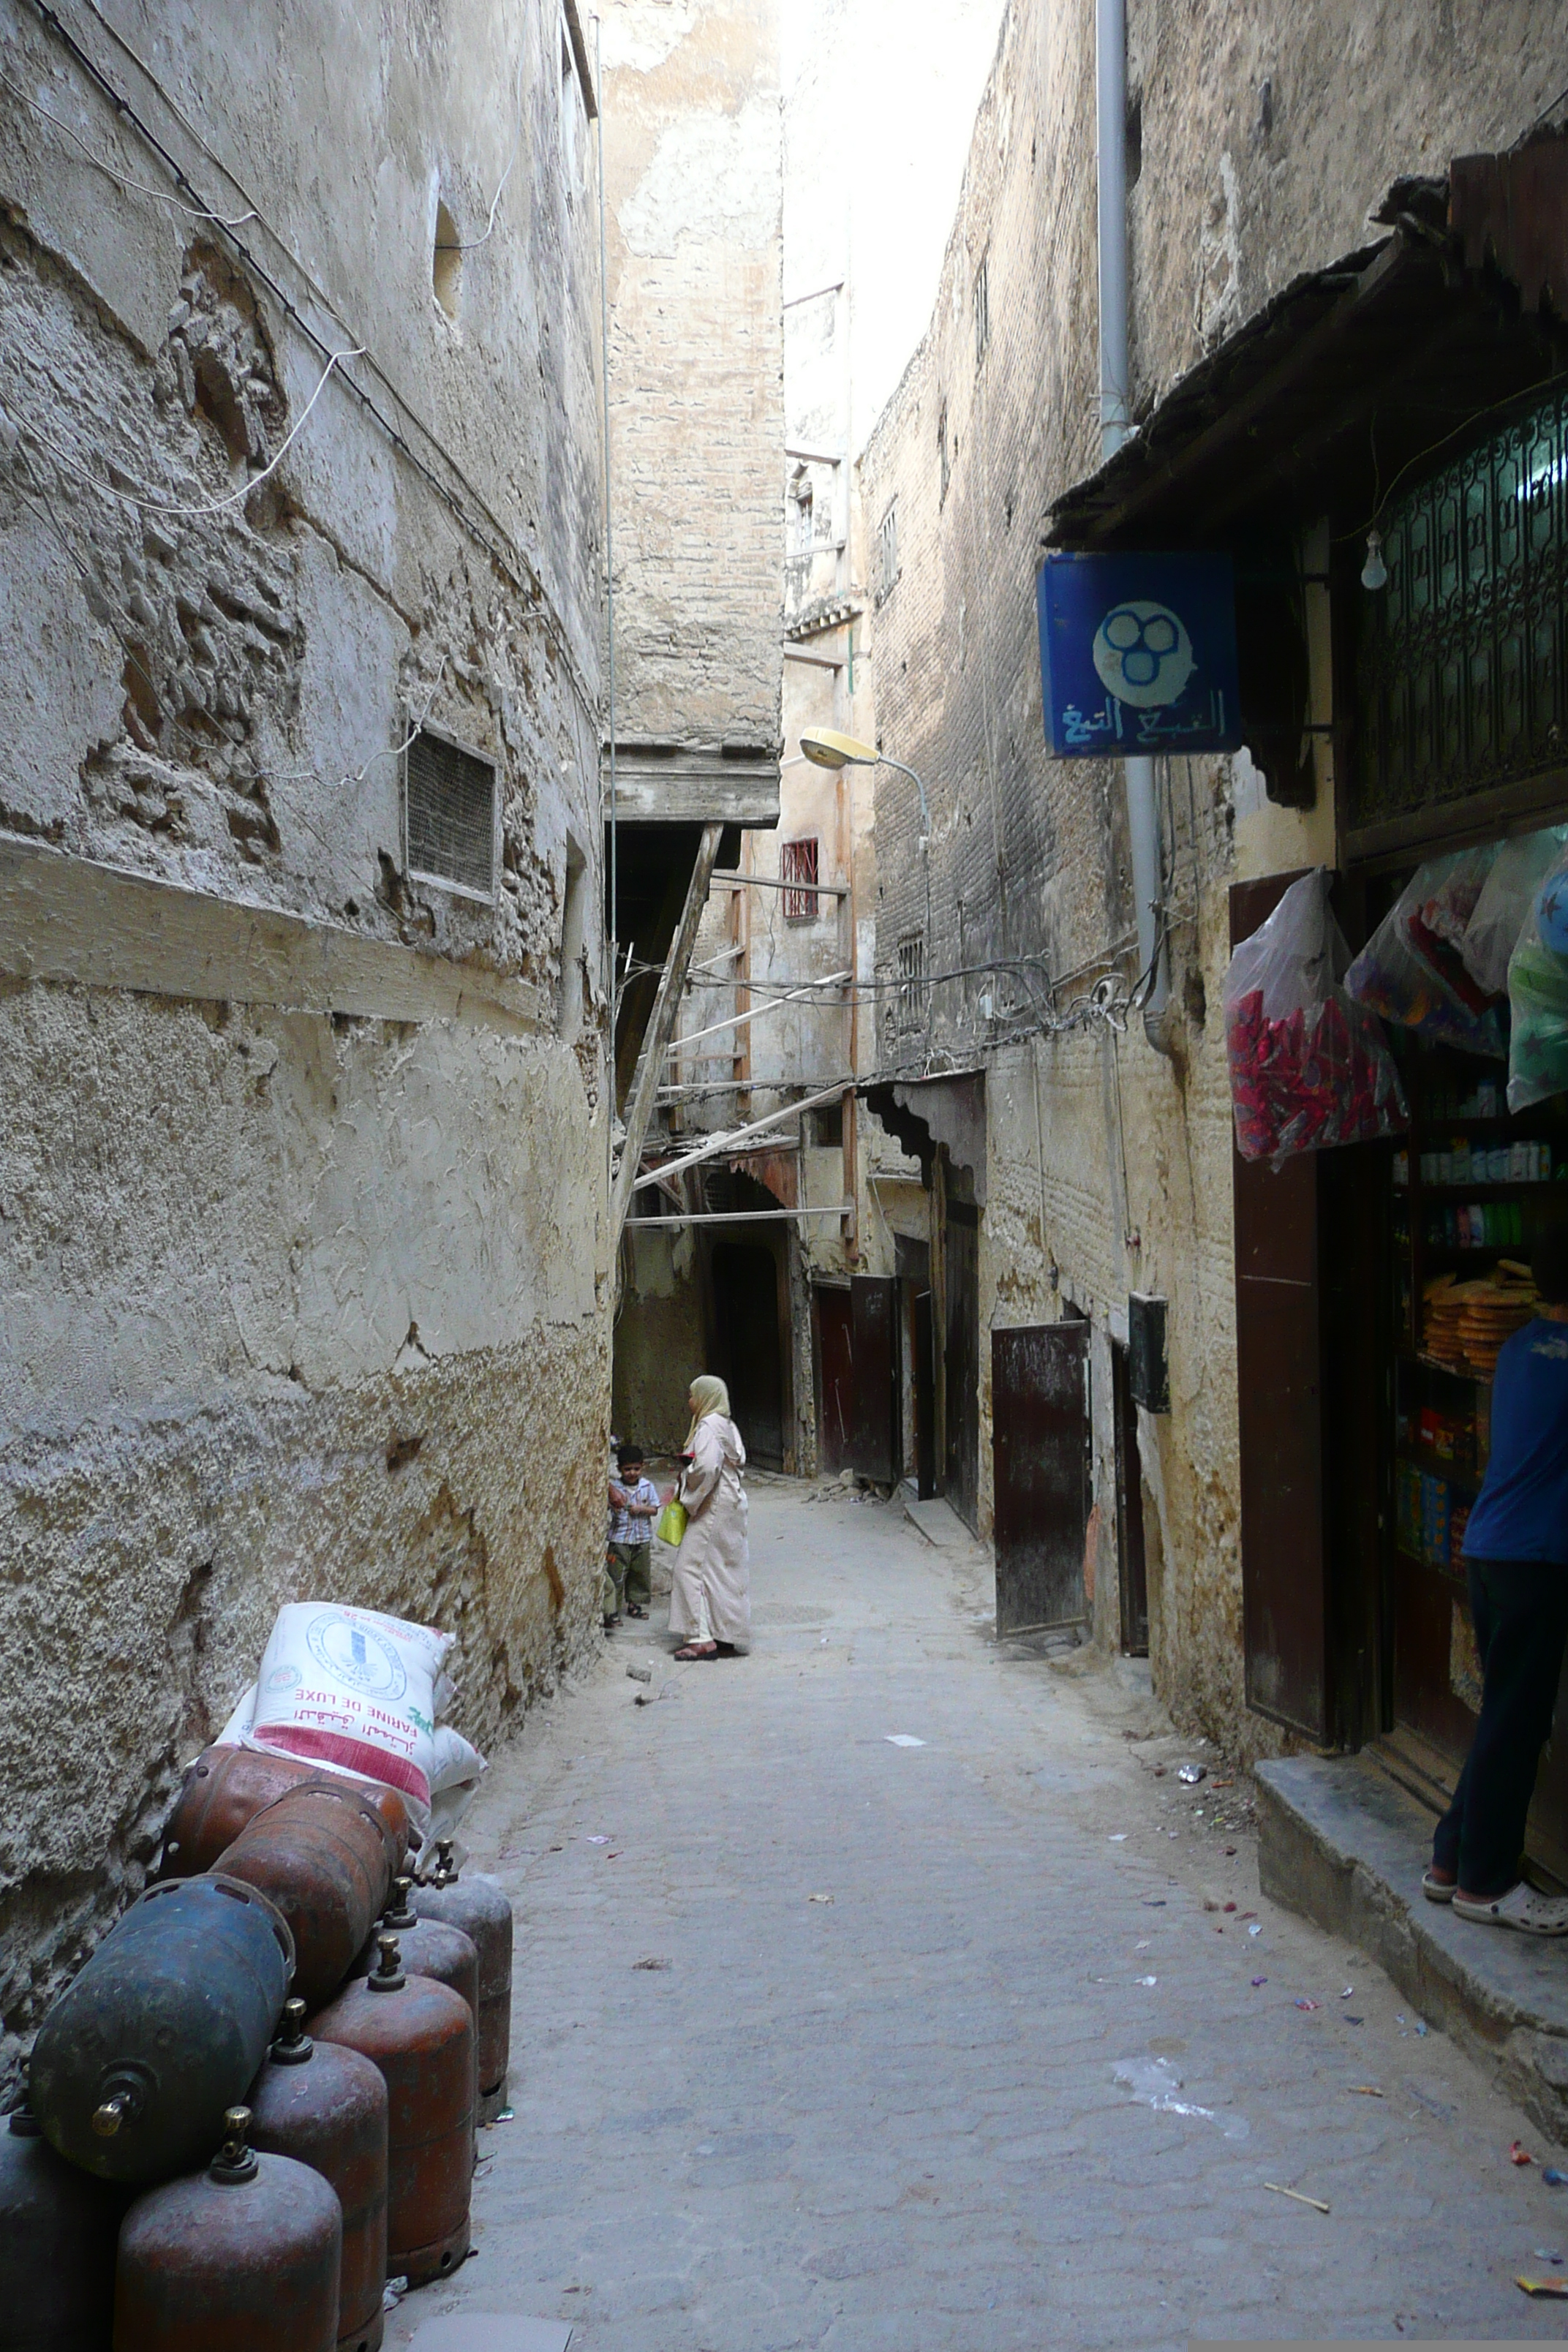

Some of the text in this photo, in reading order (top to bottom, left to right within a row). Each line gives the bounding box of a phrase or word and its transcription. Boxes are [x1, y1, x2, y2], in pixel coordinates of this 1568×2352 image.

[1062, 696, 1121, 742] التبغ
[295, 1689, 336, 1705] LUXE
[342, 1697, 361, 1712] DE
[294, 1710, 355, 1729] الدقيق
[362, 1722, 416, 1755] الممتاز
[368, 1706, 417, 1738] FARINE
